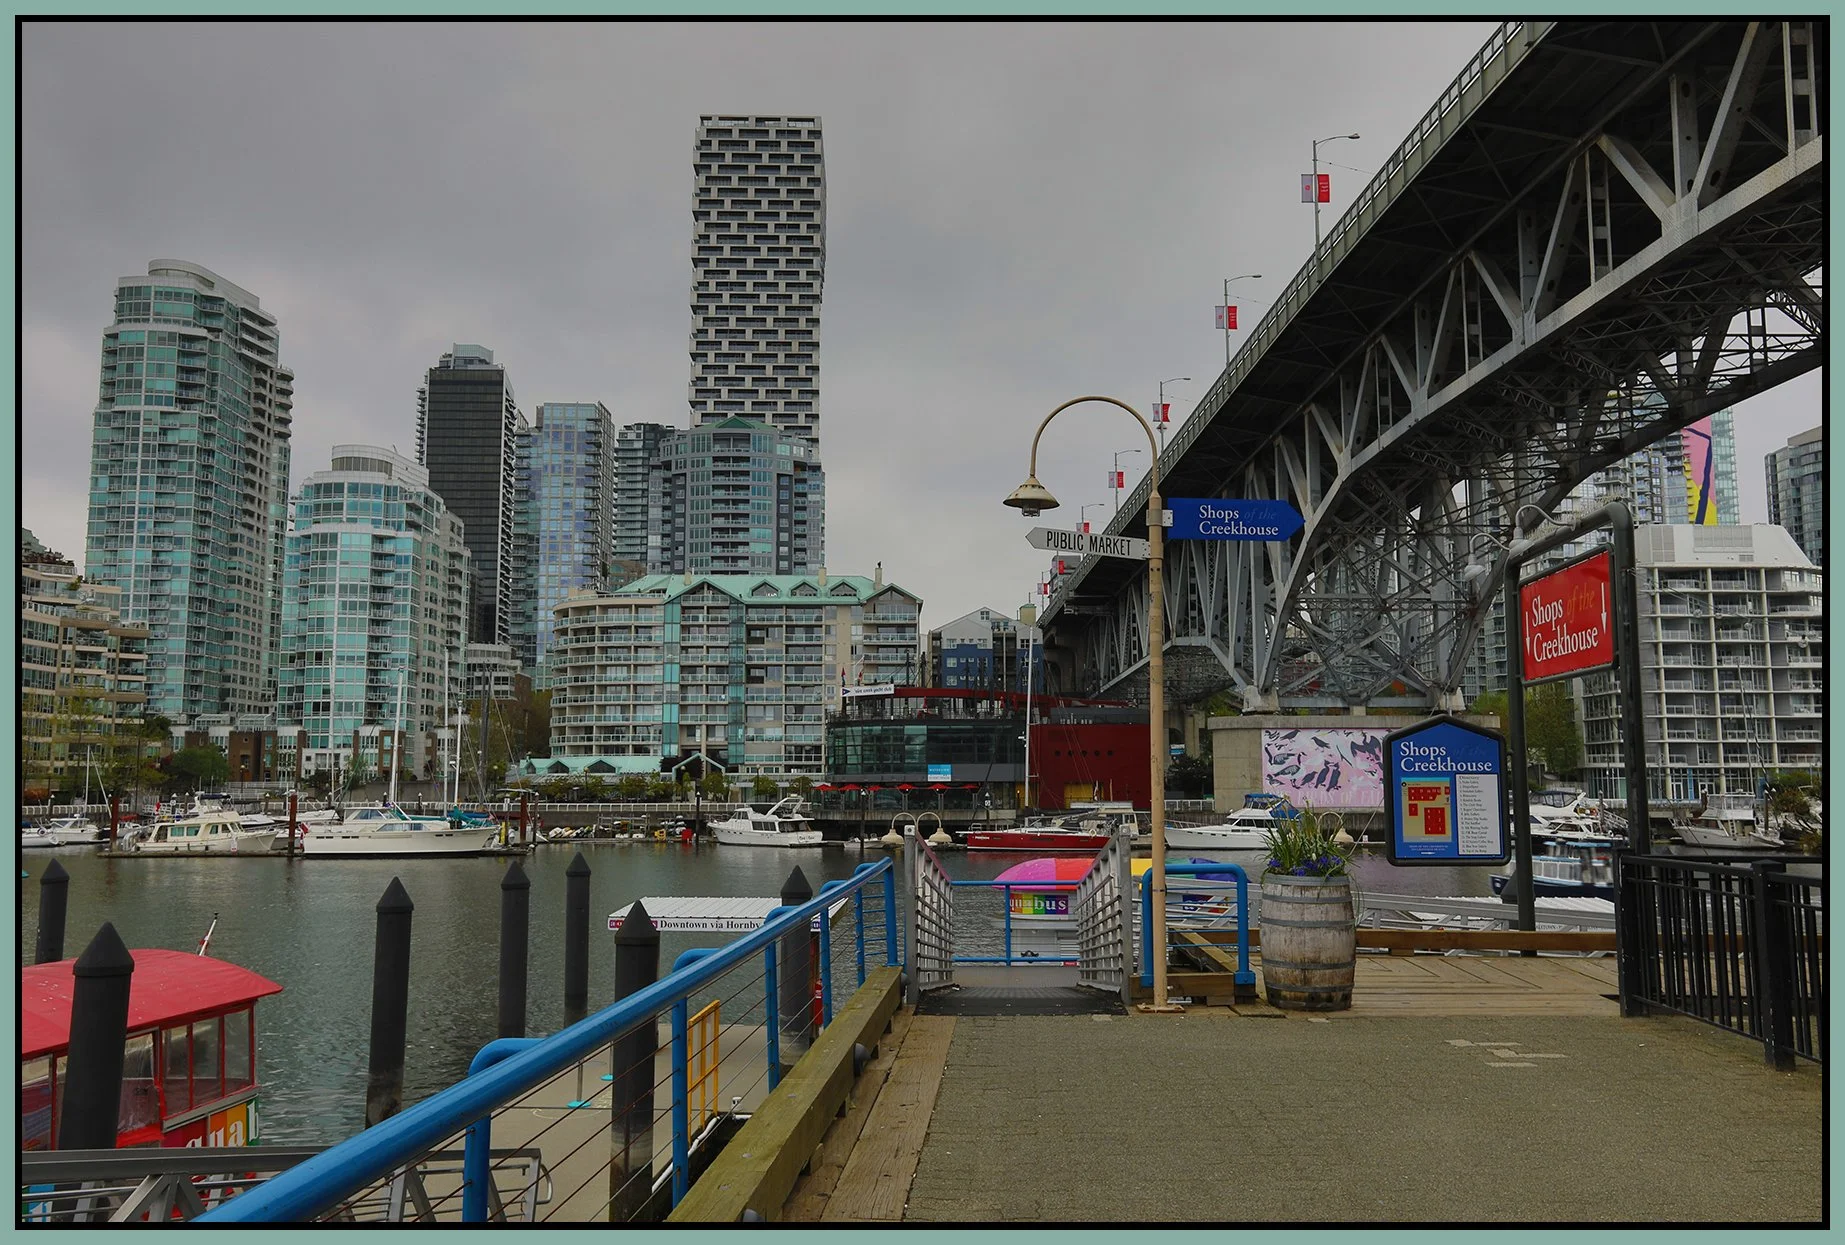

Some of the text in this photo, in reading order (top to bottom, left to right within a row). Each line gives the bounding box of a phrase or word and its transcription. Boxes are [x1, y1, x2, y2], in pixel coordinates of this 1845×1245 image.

[1199, 505, 1239, 523] Shops
[1199, 521, 1279, 535] Creekhouse
[1046, 531, 1131, 556] PUBLIC MARKET
[1532, 595, 1563, 631] Shops
[1533, 623, 1599, 662] Creekhouse
[1400, 741, 1447, 761] Shops
[1400, 757, 1492, 772] Creekhouse
[660, 920, 709, 929] Downtown
[710, 920, 723, 929] via
